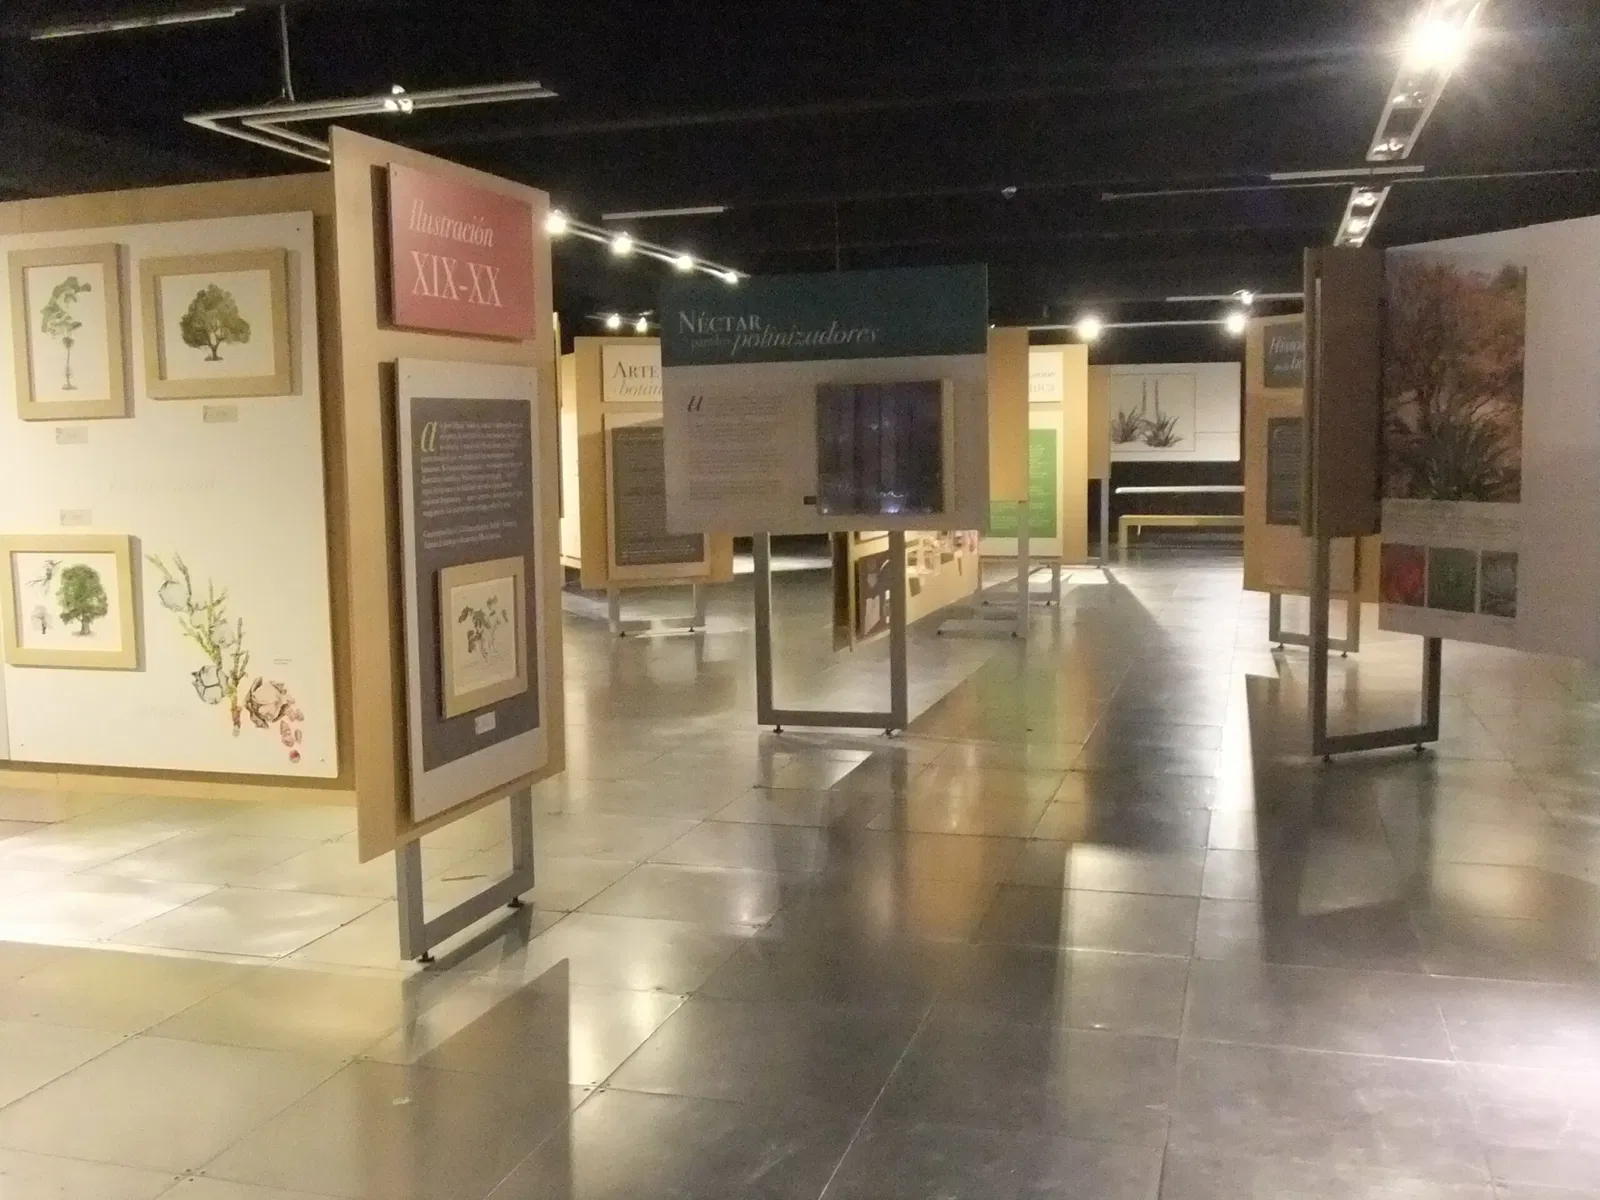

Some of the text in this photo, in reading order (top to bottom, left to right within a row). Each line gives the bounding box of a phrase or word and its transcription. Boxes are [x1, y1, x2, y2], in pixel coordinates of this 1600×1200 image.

[409, 199, 495, 247] Ilustración
[410, 251, 503, 307] XIX-XX
[731, 321, 880, 356] polinizadores
